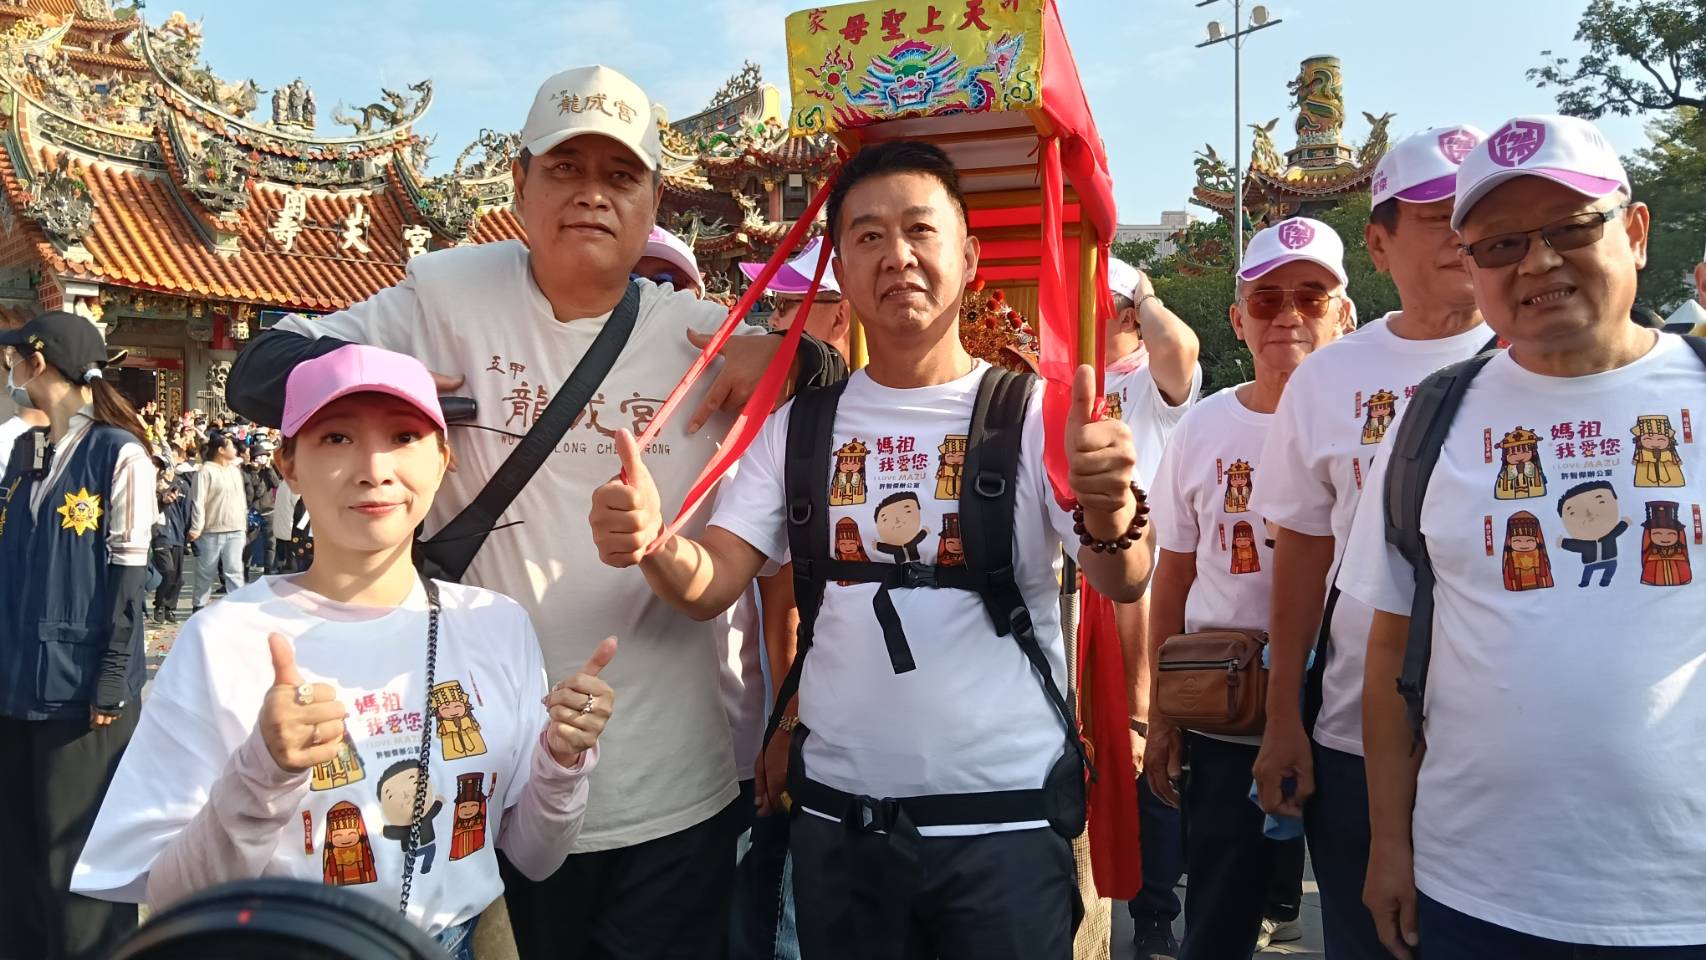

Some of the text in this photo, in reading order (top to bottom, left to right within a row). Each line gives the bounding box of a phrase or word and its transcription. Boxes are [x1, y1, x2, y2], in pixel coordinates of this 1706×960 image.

[486, 355, 526, 380] 五甲
[1551, 420, 1602, 441] 媽祖
[876, 435, 916, 454] 媽祖
[1555, 438, 1621, 460] 我愛您
[878, 453, 928, 472] 我愛您
[354, 691, 404, 715] 媽祖
[367, 712, 423, 736] 我愛您
